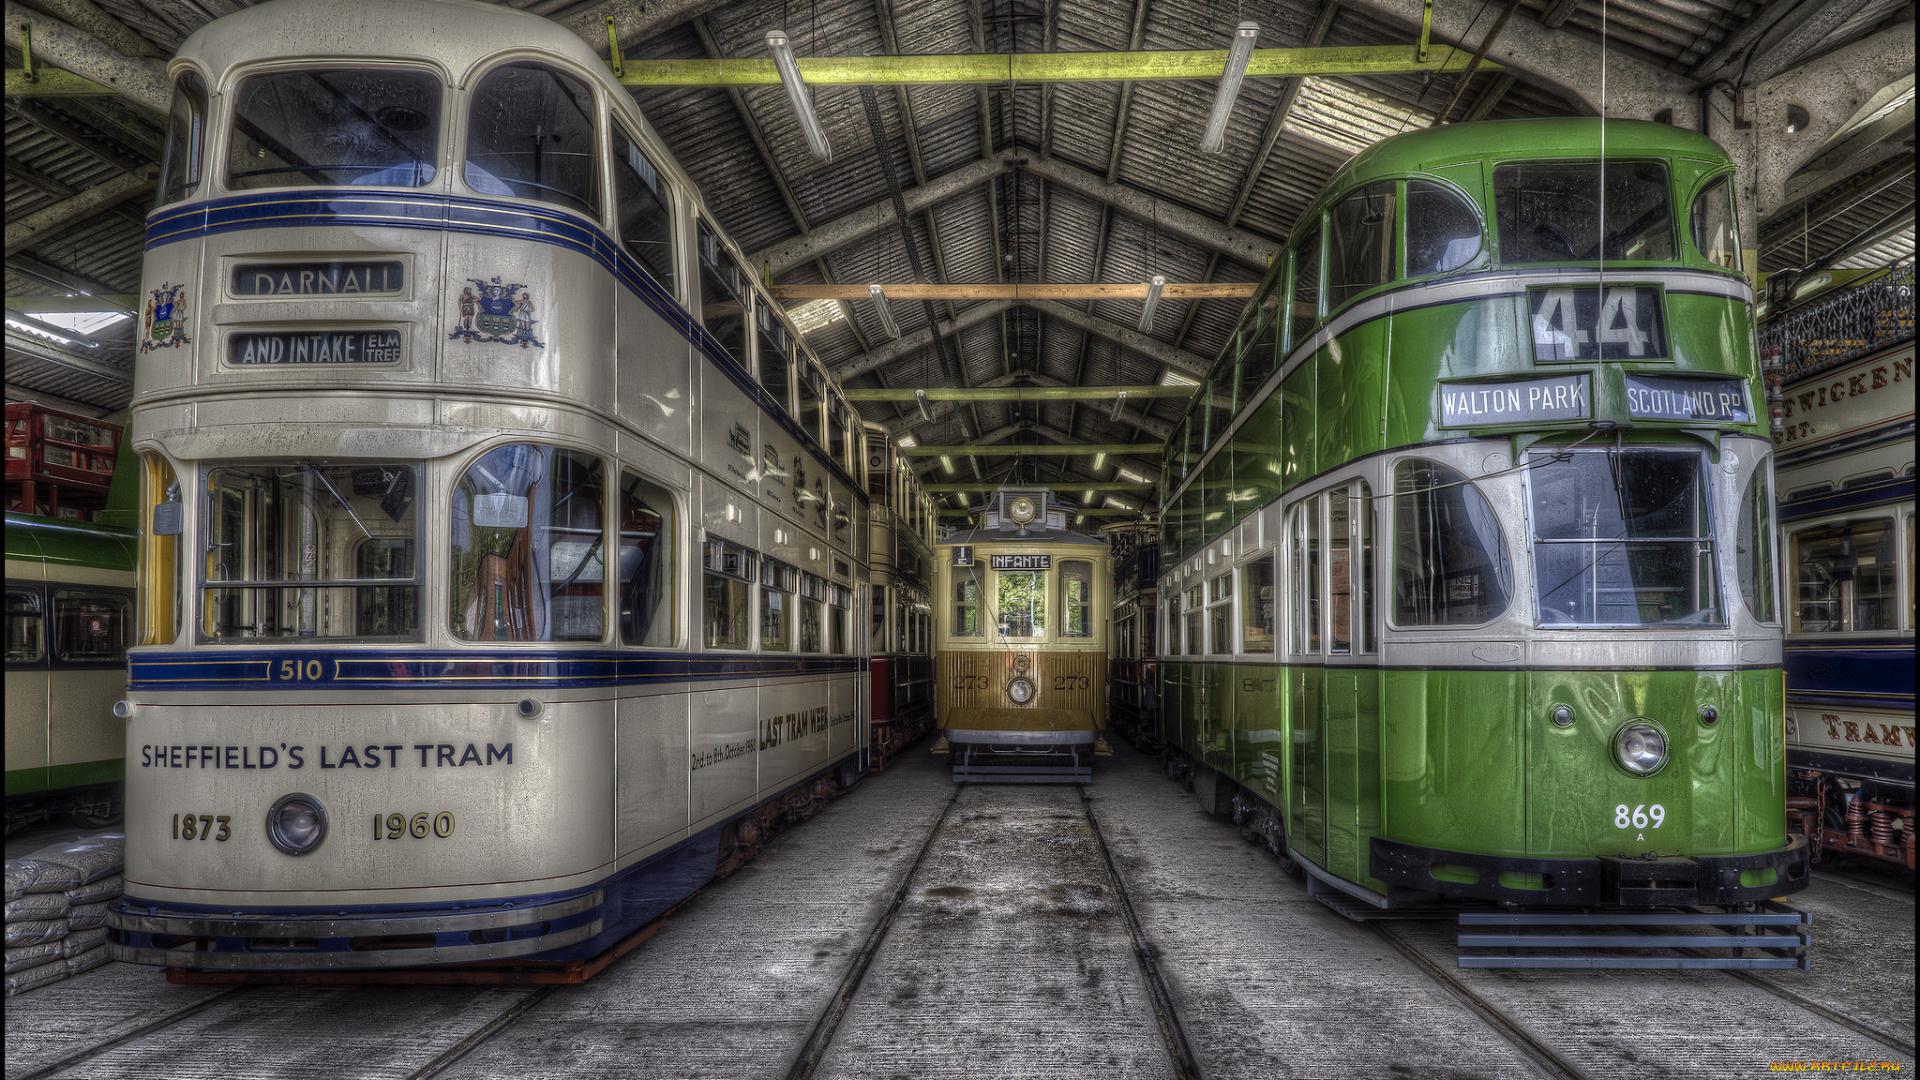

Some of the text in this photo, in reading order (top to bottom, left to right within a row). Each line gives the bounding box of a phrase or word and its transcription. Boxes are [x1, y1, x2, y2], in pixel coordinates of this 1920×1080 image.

[255, 266, 398, 295] DARNALL
[1532, 286, 1649, 357] 44
[242, 335, 356, 364] AND INTAKE
[368, 335, 399, 347] ELM
[366, 348, 400, 362] TREE
[1442, 383, 1586, 416] WALTON PARK
[1628, 387, 1715, 416] SCOTLAND
[992, 555, 1050, 568] INFANTE
[280, 659, 322, 681] 510
[954, 676, 989, 690] 273
[1054, 676, 1089, 690] 273
[759, 715, 784, 751] LAST
[786, 711, 808, 742] TRAM
[810, 706, 829, 734] WEEK
[141, 742, 514, 769] SHEFFIELD'S LAST TRAM
[706, 754, 713, 766] to
[172, 813, 232, 841] 1873
[373, 810, 456, 841] 1960
[1614, 803, 1666, 829] 869
[1636, 832, 1645, 842] A
